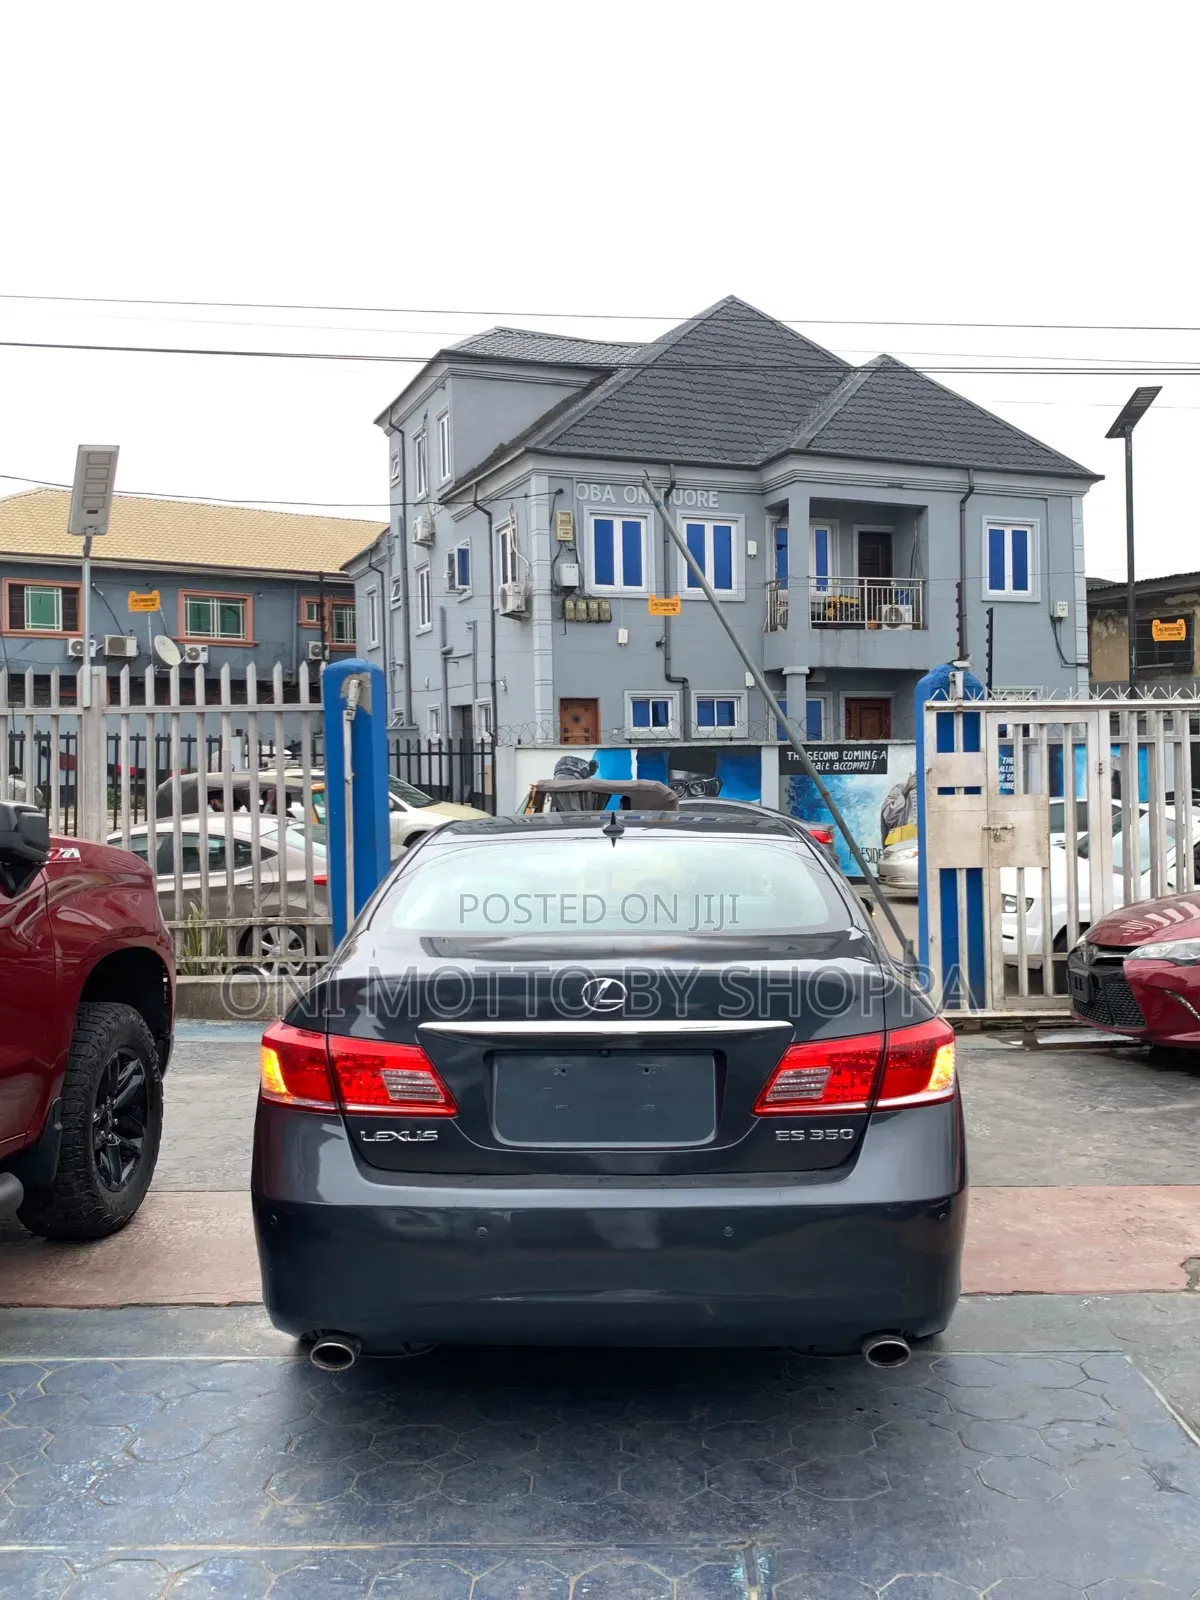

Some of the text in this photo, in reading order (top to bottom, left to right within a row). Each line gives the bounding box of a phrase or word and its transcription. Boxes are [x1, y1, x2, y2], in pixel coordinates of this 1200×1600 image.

[575, 482, 617, 503] OBA
[806, 750, 839, 761] SECOND
[999, 782, 1015, 790] POWE
[360, 1130, 439, 1142] LEXUS
[775, 1128, 854, 1141] ES 350
